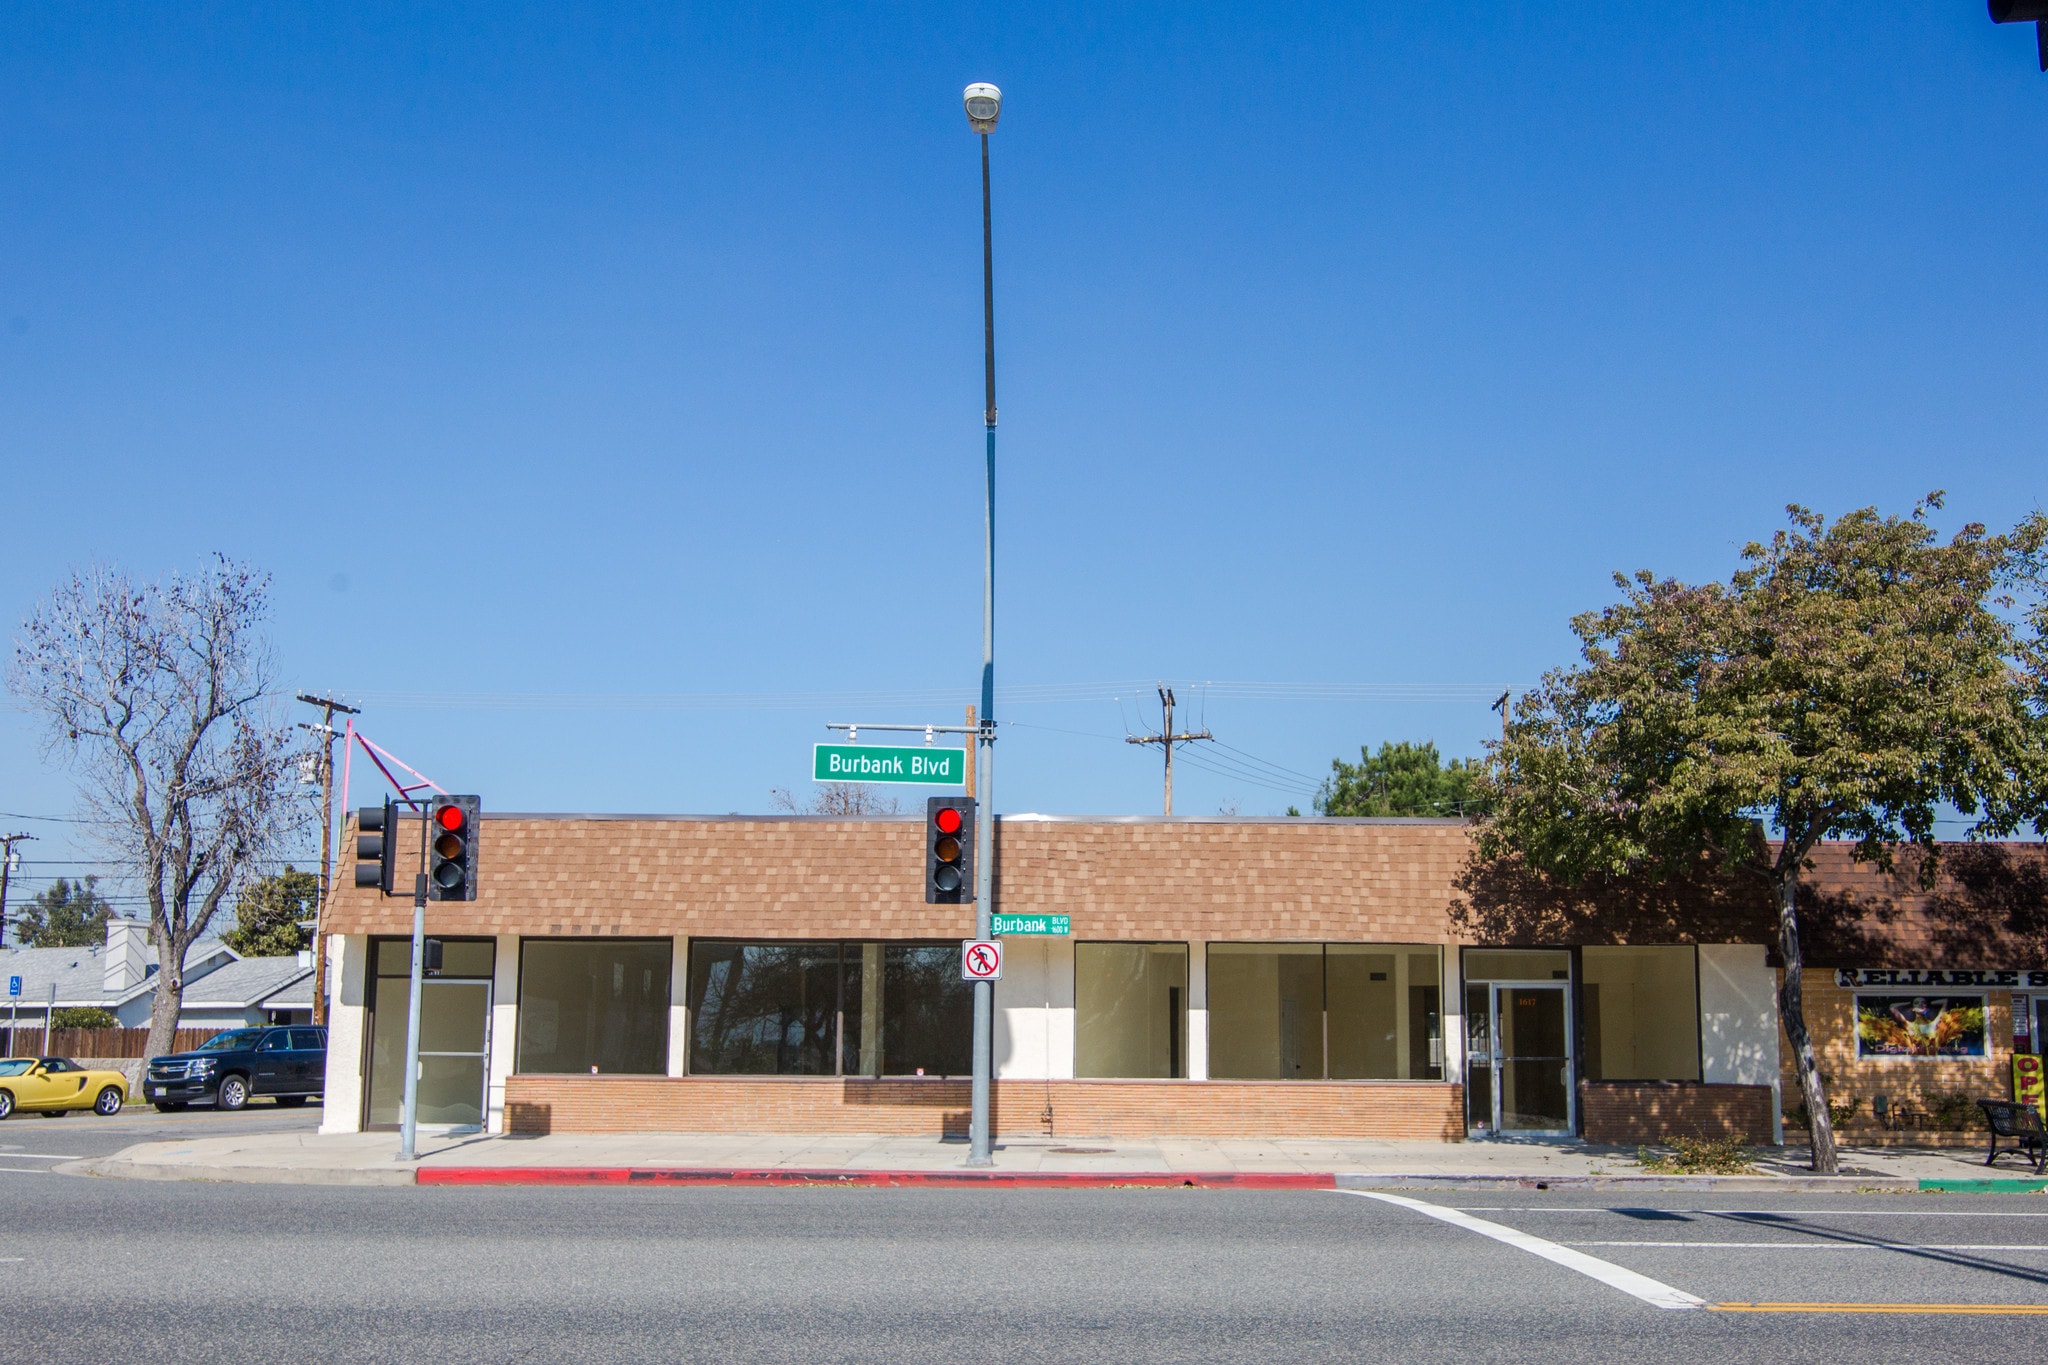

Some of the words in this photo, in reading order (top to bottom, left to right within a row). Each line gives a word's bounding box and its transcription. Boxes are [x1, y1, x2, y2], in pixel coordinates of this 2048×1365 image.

[829, 753, 904, 775] Burbank
[911, 756, 950, 776] Blvd
[994, 917, 1047, 932] Burbank
[1052, 917, 1069, 925] BLVD
[1838, 968, 2019, 987] RELIABLE
